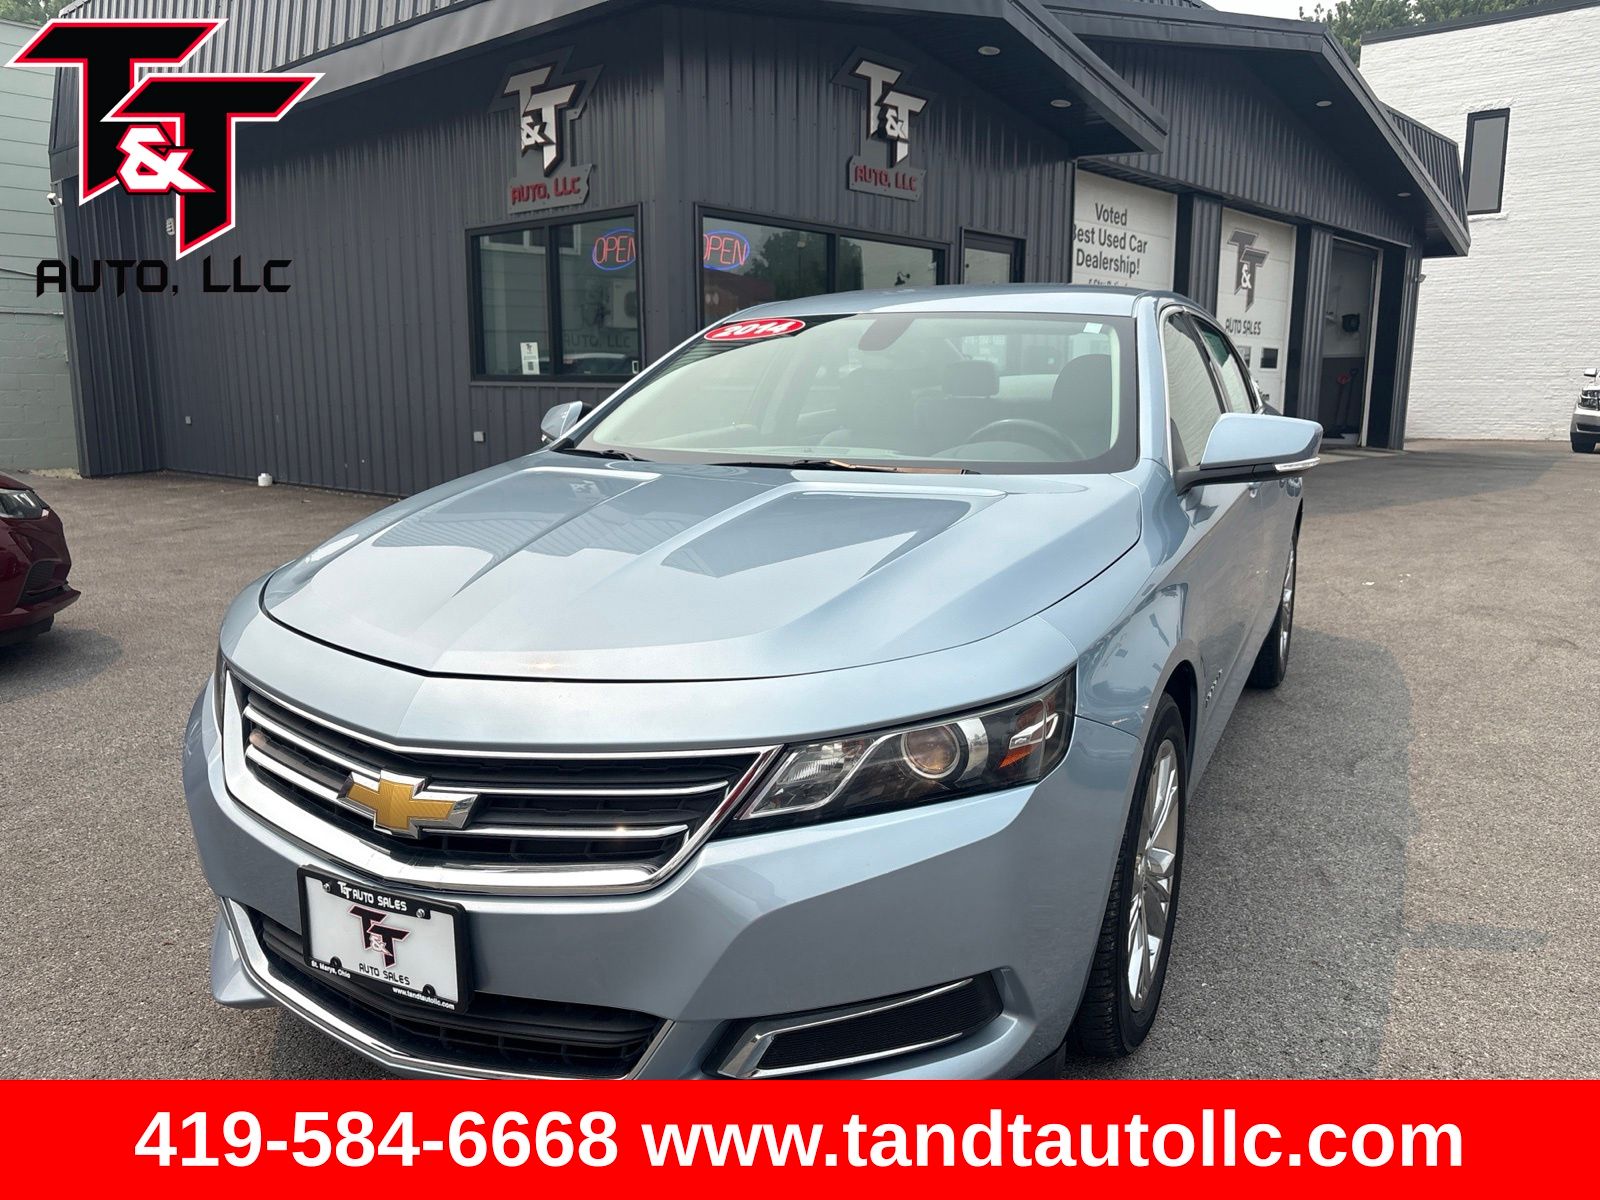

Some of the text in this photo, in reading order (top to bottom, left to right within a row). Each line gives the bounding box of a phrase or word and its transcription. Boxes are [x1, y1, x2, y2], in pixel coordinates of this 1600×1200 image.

[503, 66, 577, 170] T&T
[855, 60, 928, 163] T&T
[511, 176, 581, 205] AUTO, LLC
[854, 164, 917, 191] AUTO, LLC
[1095, 202, 1128, 226] Voted
[1098, 228, 1127, 250] Used
[1129, 234, 1148, 254] Car
[1076, 248, 1141, 278] Dealership!
[1227, 228, 1269, 312] T&T
[712, 321, 796, 339] 2014
[1225, 317, 1262, 336] AUTO SALES
[352, 889, 374, 904] AUTO
[377, 895, 407, 911] SALES
[348, 904, 411, 969] T&T
[359, 962, 411, 986] AUTO SALES
